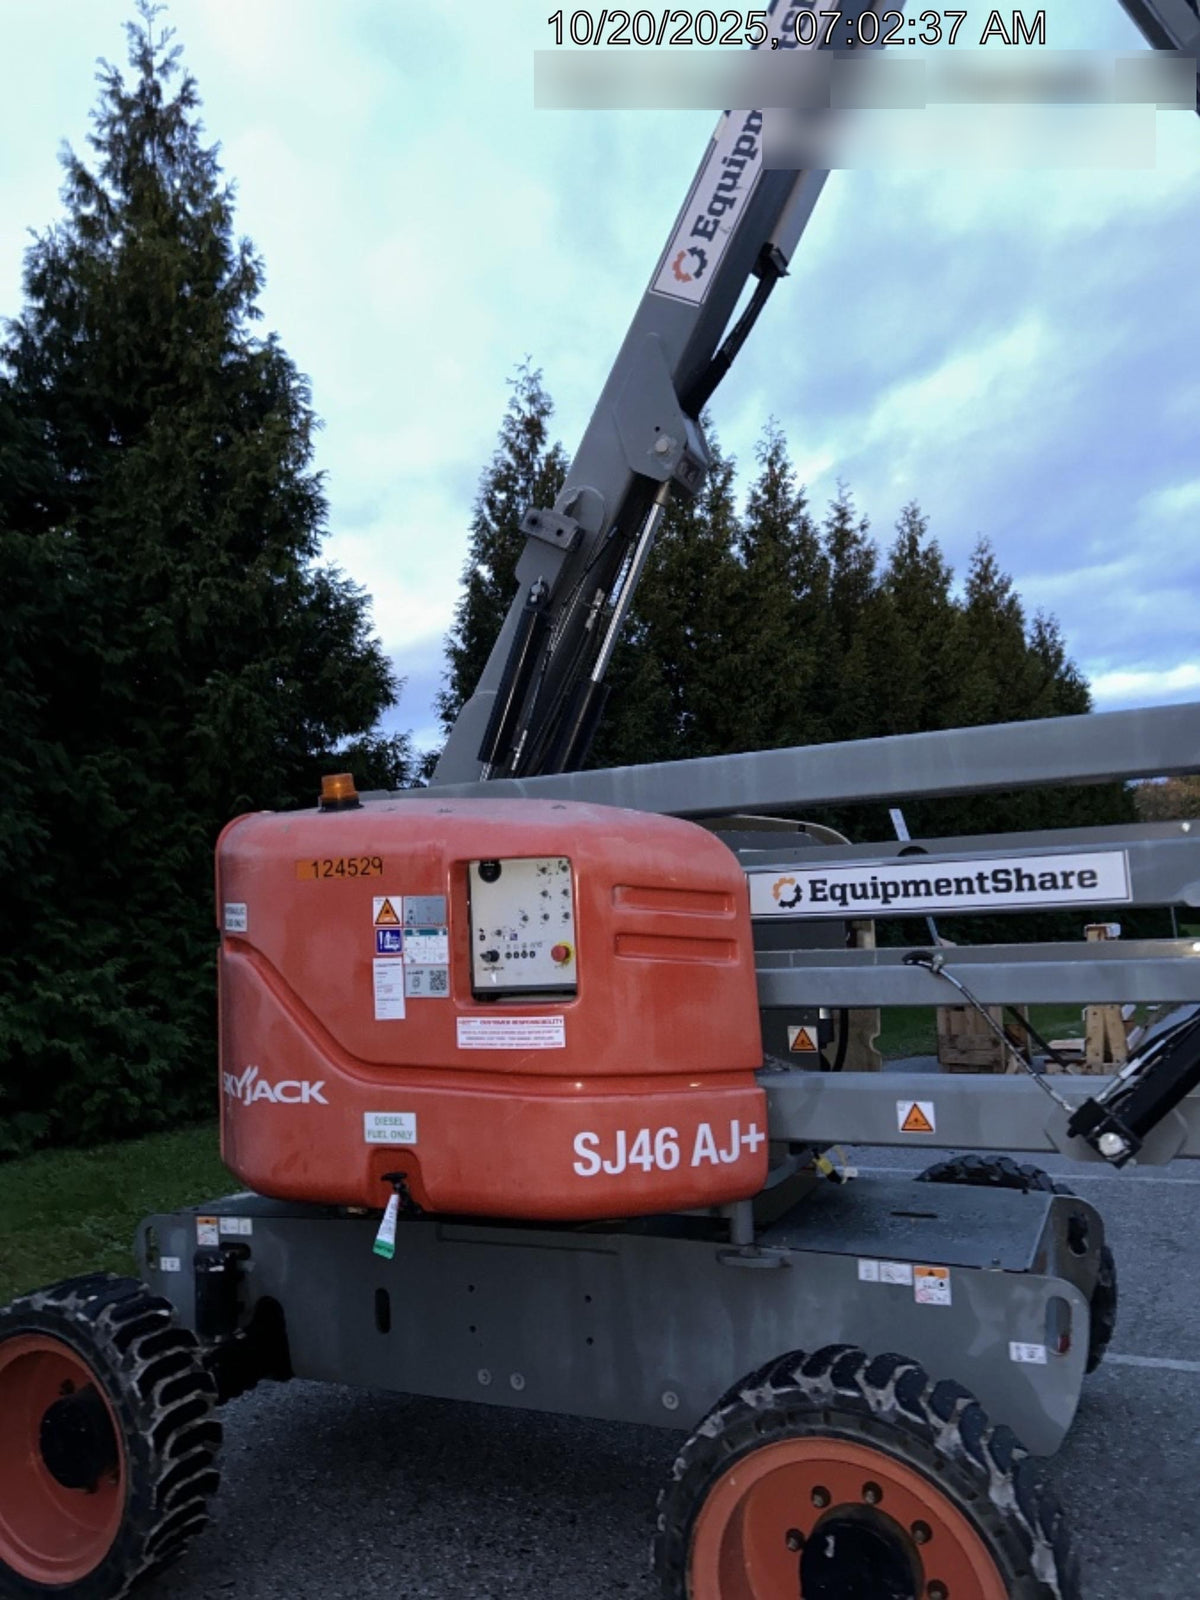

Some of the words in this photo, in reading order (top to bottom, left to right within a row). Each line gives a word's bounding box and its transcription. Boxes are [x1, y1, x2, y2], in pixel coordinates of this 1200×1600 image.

[312, 856, 383, 878] 124529
[809, 867, 1098, 906] EquipmentShare
[374, 1116, 405, 1126] DIESEL
[367, 1129, 387, 1138] FUEL
[390, 1130, 413, 1139] ONLY
[573, 1127, 680, 1176] SJ46
[691, 1120, 765, 1167] AJ+
